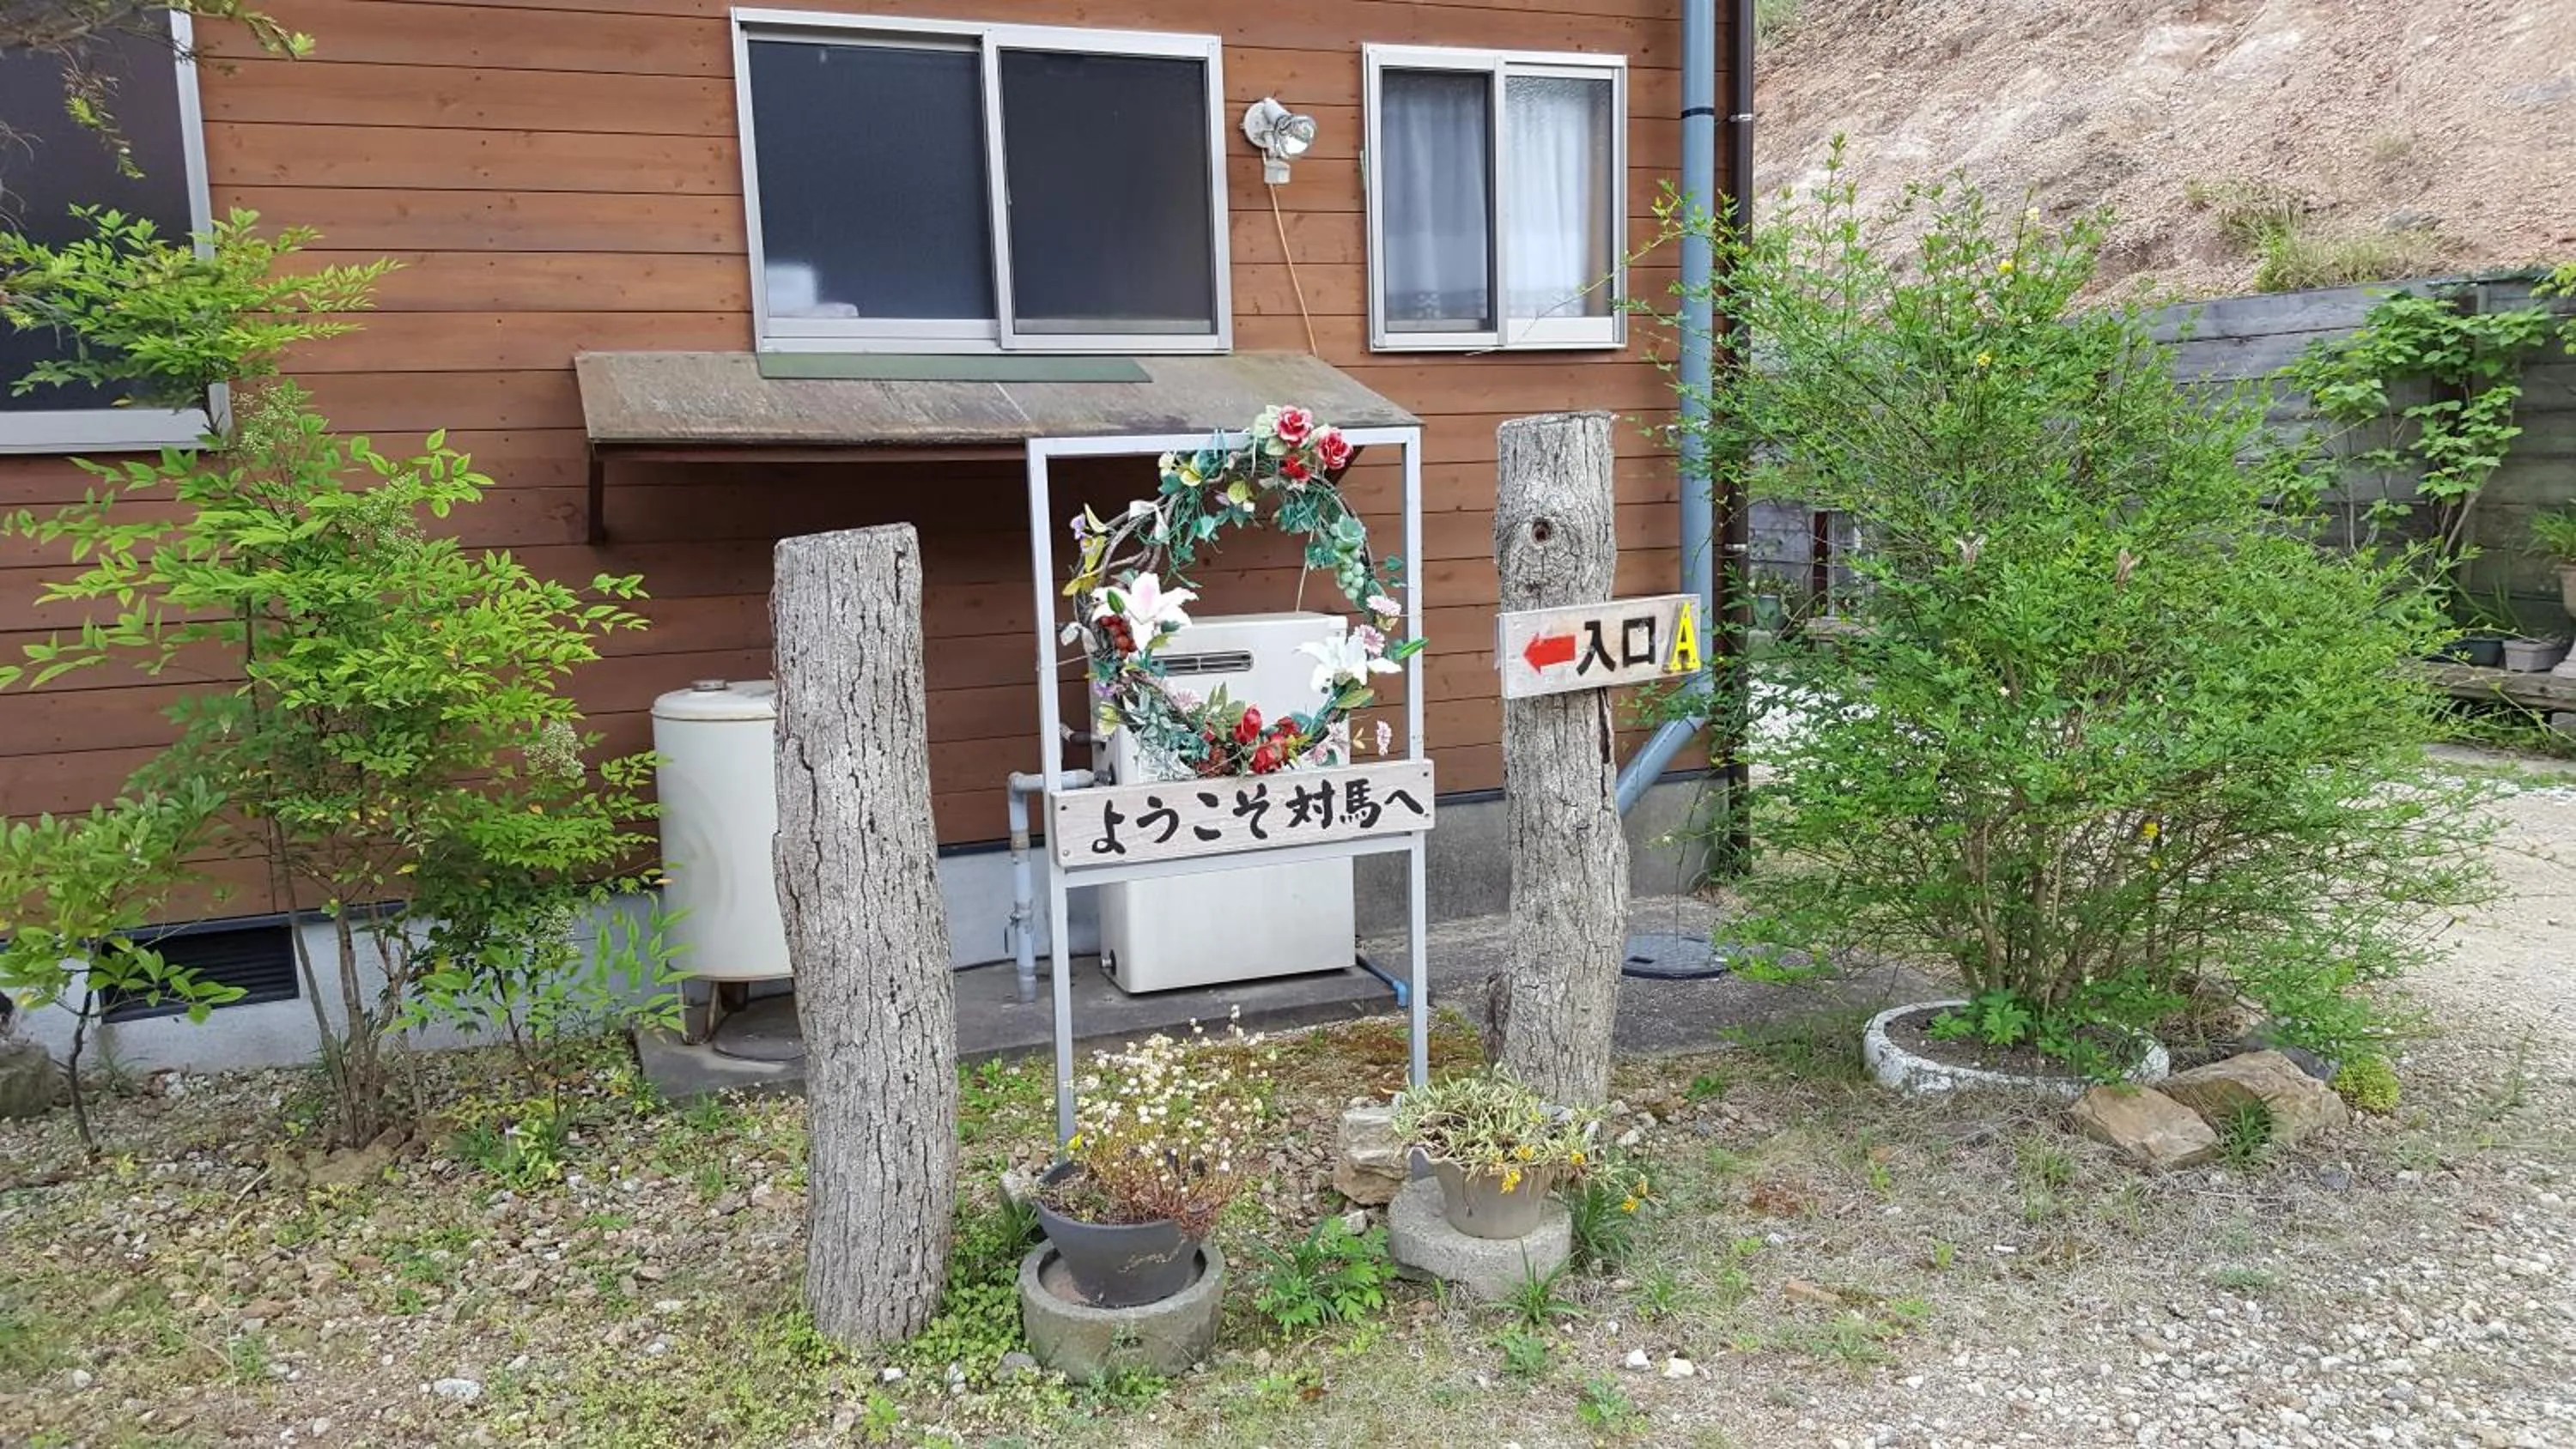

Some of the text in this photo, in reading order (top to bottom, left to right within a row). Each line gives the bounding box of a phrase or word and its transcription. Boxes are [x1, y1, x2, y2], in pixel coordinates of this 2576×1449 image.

[1091, 779, 1425, 854] ようこそ対馬へ
